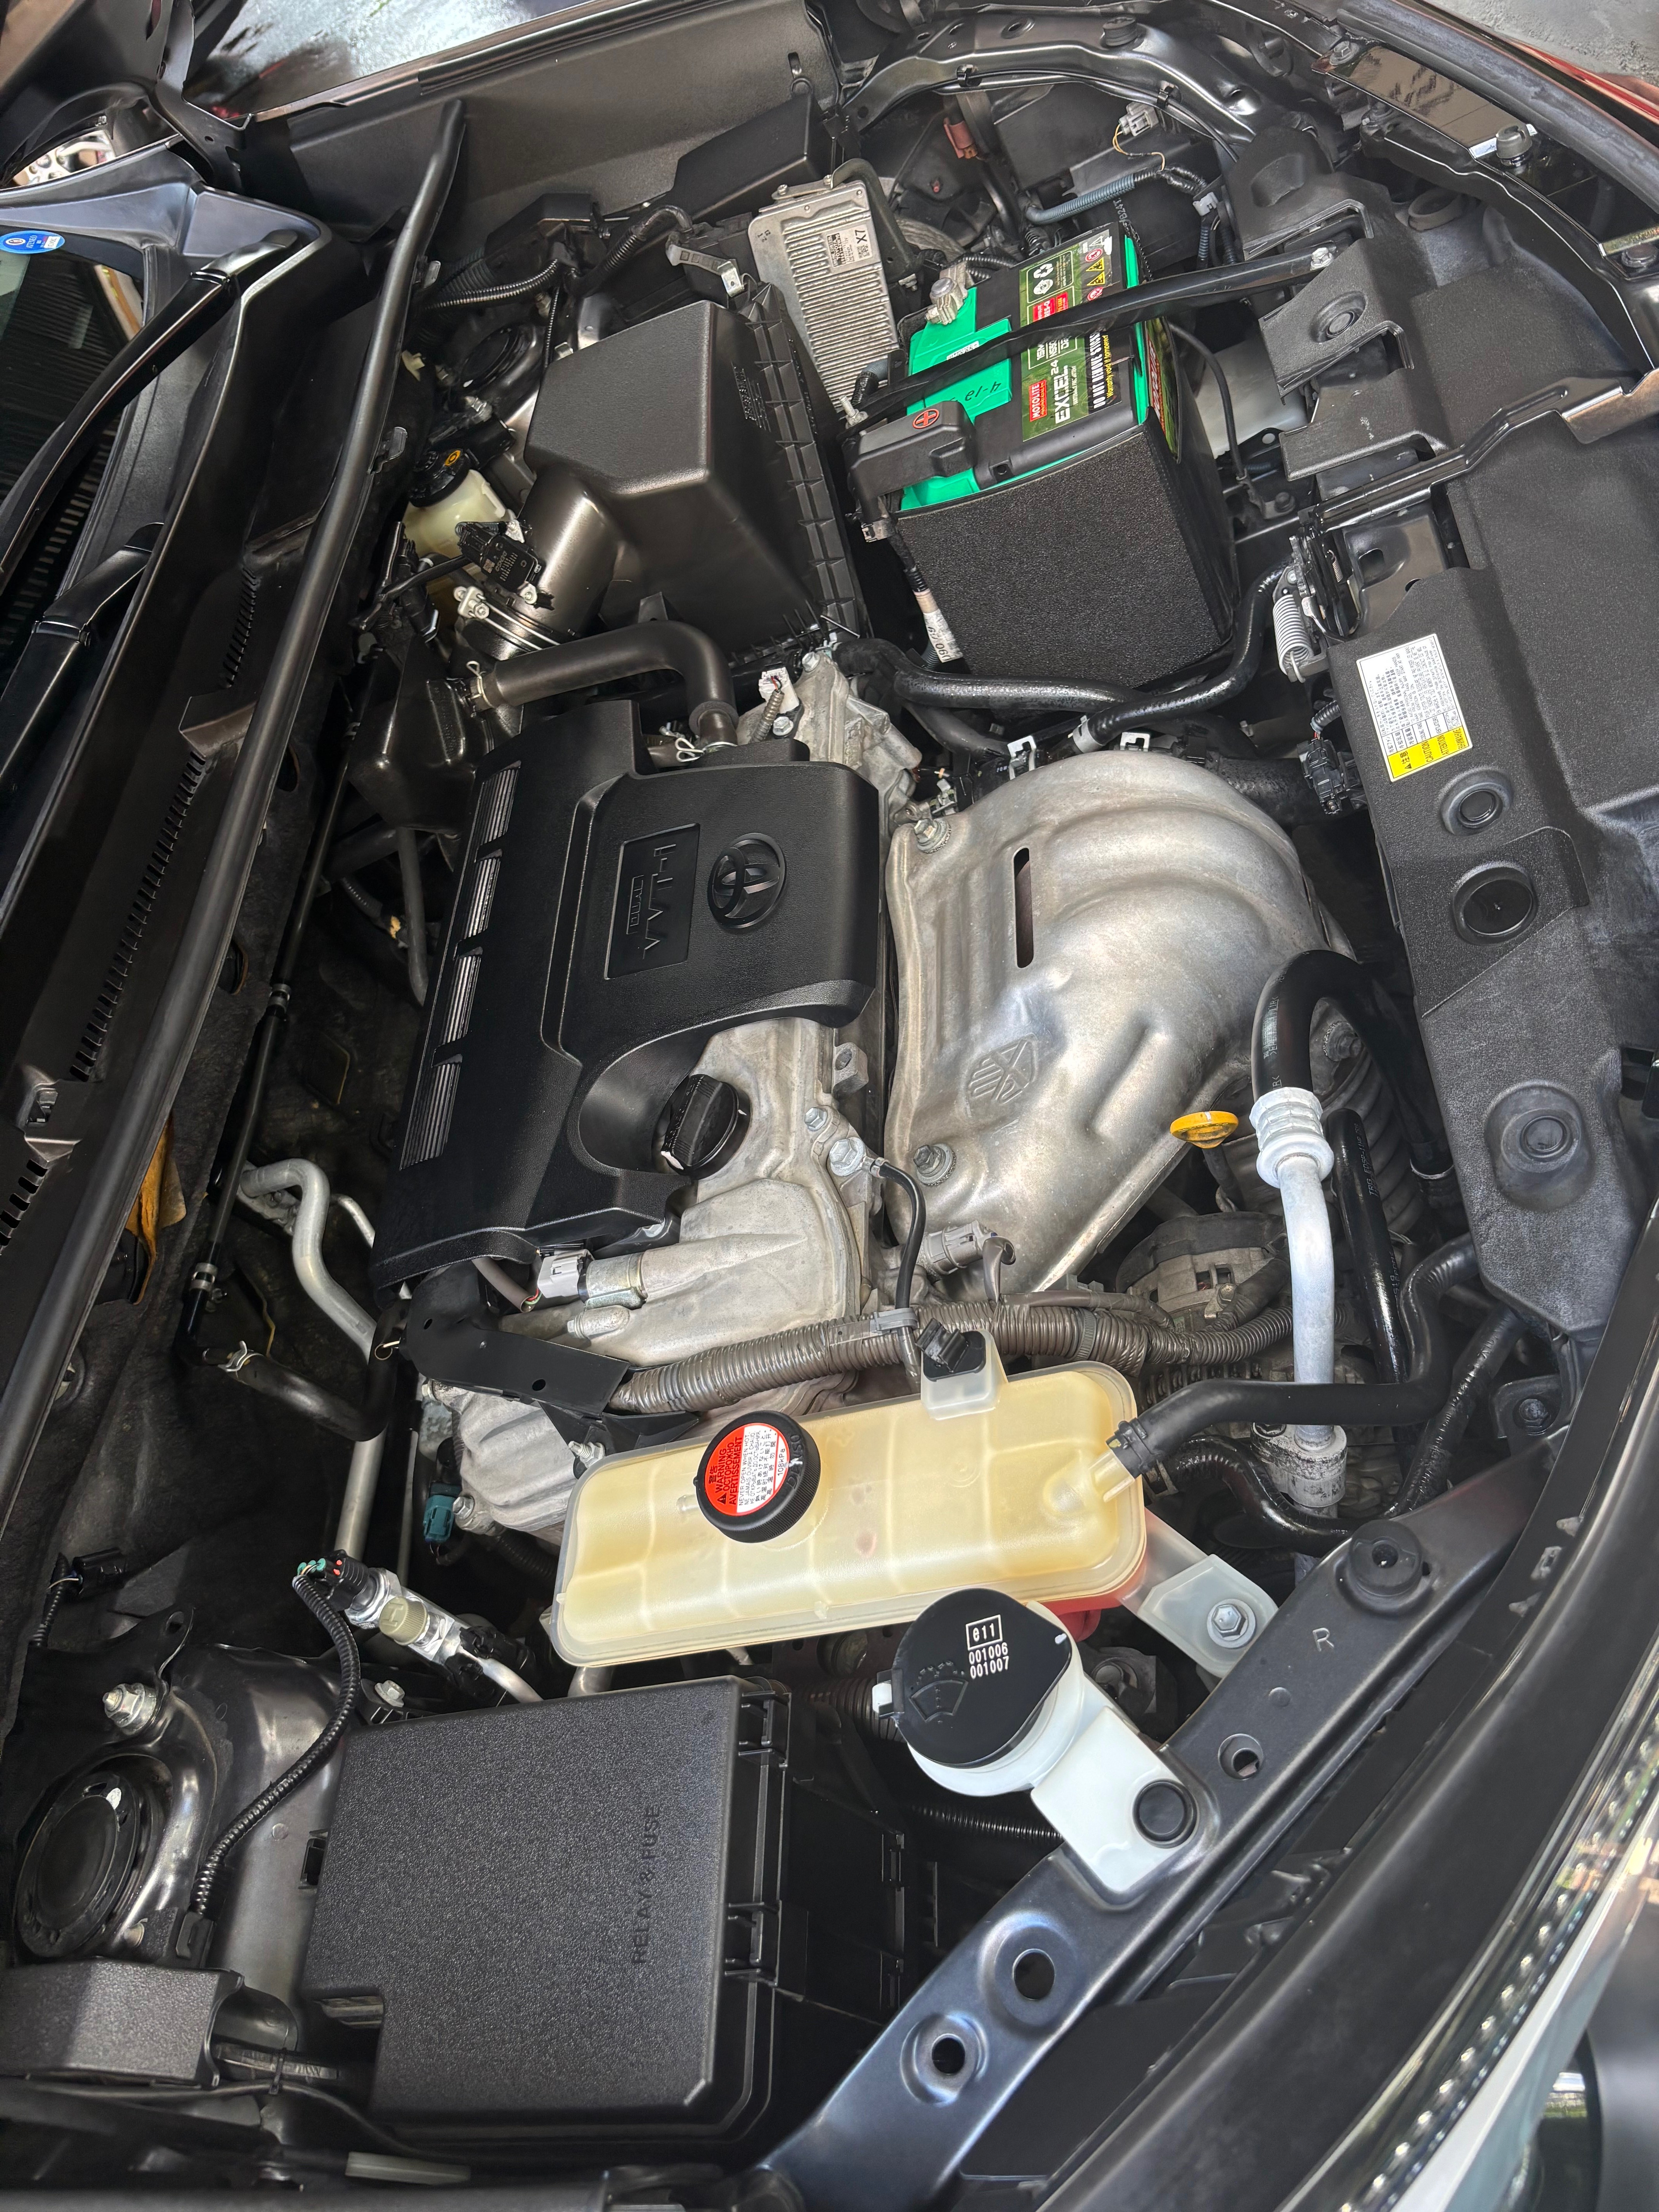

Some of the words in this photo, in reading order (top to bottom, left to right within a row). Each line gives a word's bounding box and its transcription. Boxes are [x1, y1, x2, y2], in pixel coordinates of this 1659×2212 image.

[854, 230, 867, 244] X7
[832, 239, 840, 260] TOYOTA
[1051, 360, 1058, 375] 24
[1091, 354, 1104, 382] REMOVE
[1032, 384, 1041, 418] MOTOLITE
[1054, 366, 1070, 424] EXCEL
[1093, 382, 1105, 397] NOT
[1094, 397, 1106, 409] DO
[1420, 740, 1434, 763] CAUTION
[1436, 734, 1449, 756] ATTENTION
[1399, 750, 1410, 764] 注意
[629, 880, 643, 926] DUAL
[708, 1465, 718, 1484] 警告
[716, 1448, 727, 1493] WARNING
[722, 1442, 734, 1491] ОСТОРОЖНО
[729, 1437, 742, 1505] AVERTISSEMENT
[973, 1623, 995, 1642] e11
[1312, 1627, 1334, 1652] R
[969, 1642, 1008, 1665] 001006
[970, 1656, 1009, 1679] 001007
[642, 1805, 660, 1859] FUSE
[640, 1871, 653, 1882] &
[632, 1891, 653, 1964] RELAY
